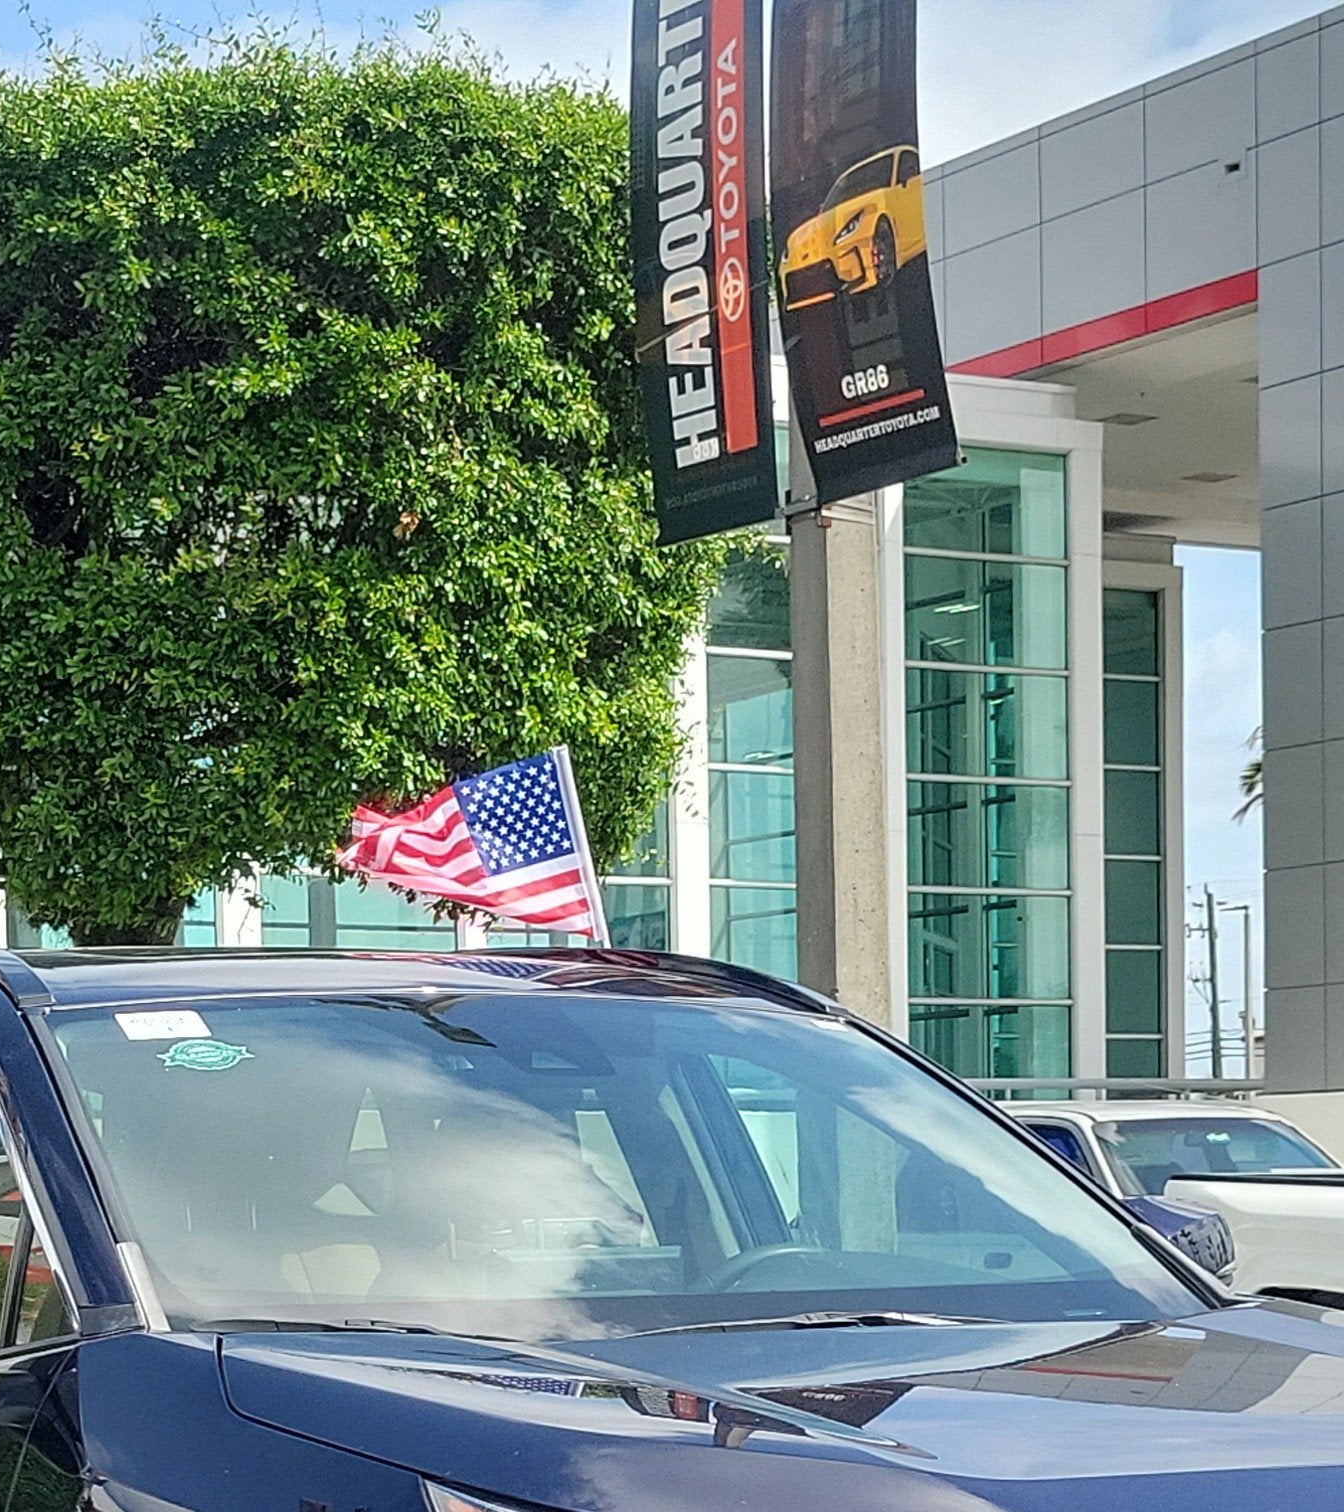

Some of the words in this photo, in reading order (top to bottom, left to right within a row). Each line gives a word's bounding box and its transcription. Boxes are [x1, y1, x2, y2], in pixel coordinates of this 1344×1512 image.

[717, 37, 741, 254] TOYOTA
[841, 364, 889, 399] GR86
[813, 405, 941, 454] HEADQUARTERTOYOTA.COM
